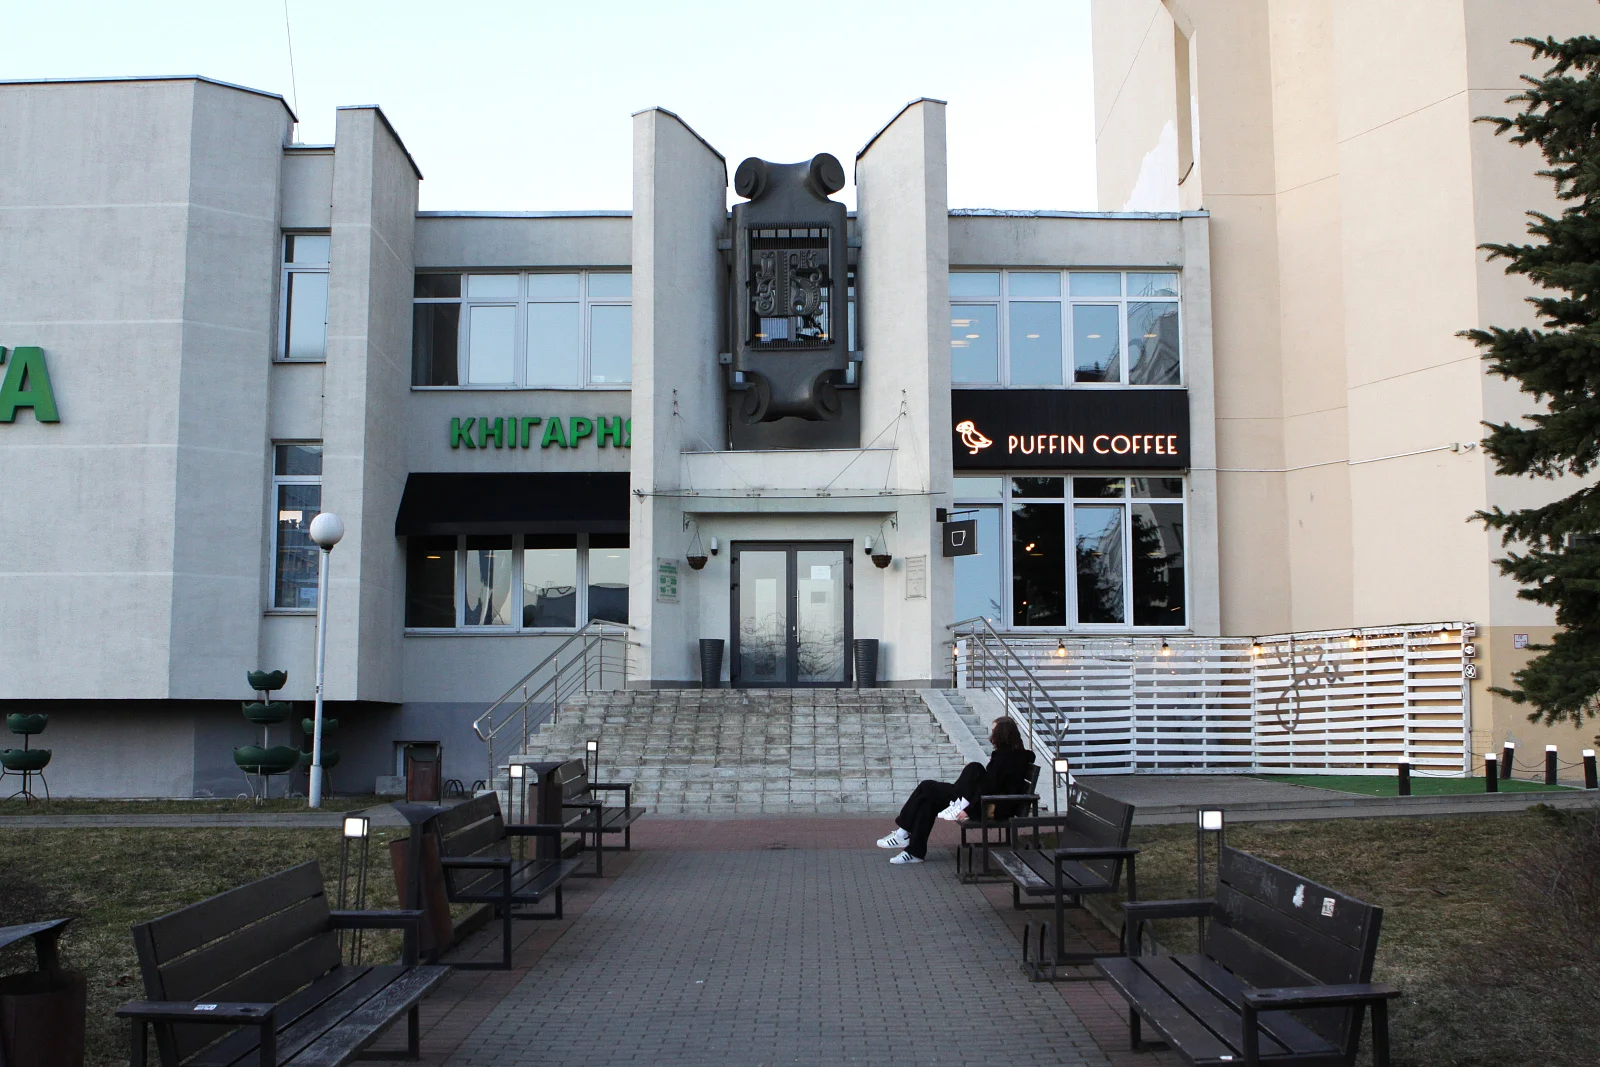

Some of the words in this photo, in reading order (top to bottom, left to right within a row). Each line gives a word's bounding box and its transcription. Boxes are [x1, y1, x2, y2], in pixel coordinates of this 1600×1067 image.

[0, 346, 60, 423] А
[1007, 435, 1085, 455] PUFFIN
[1092, 434, 1178, 455] COFFEE
